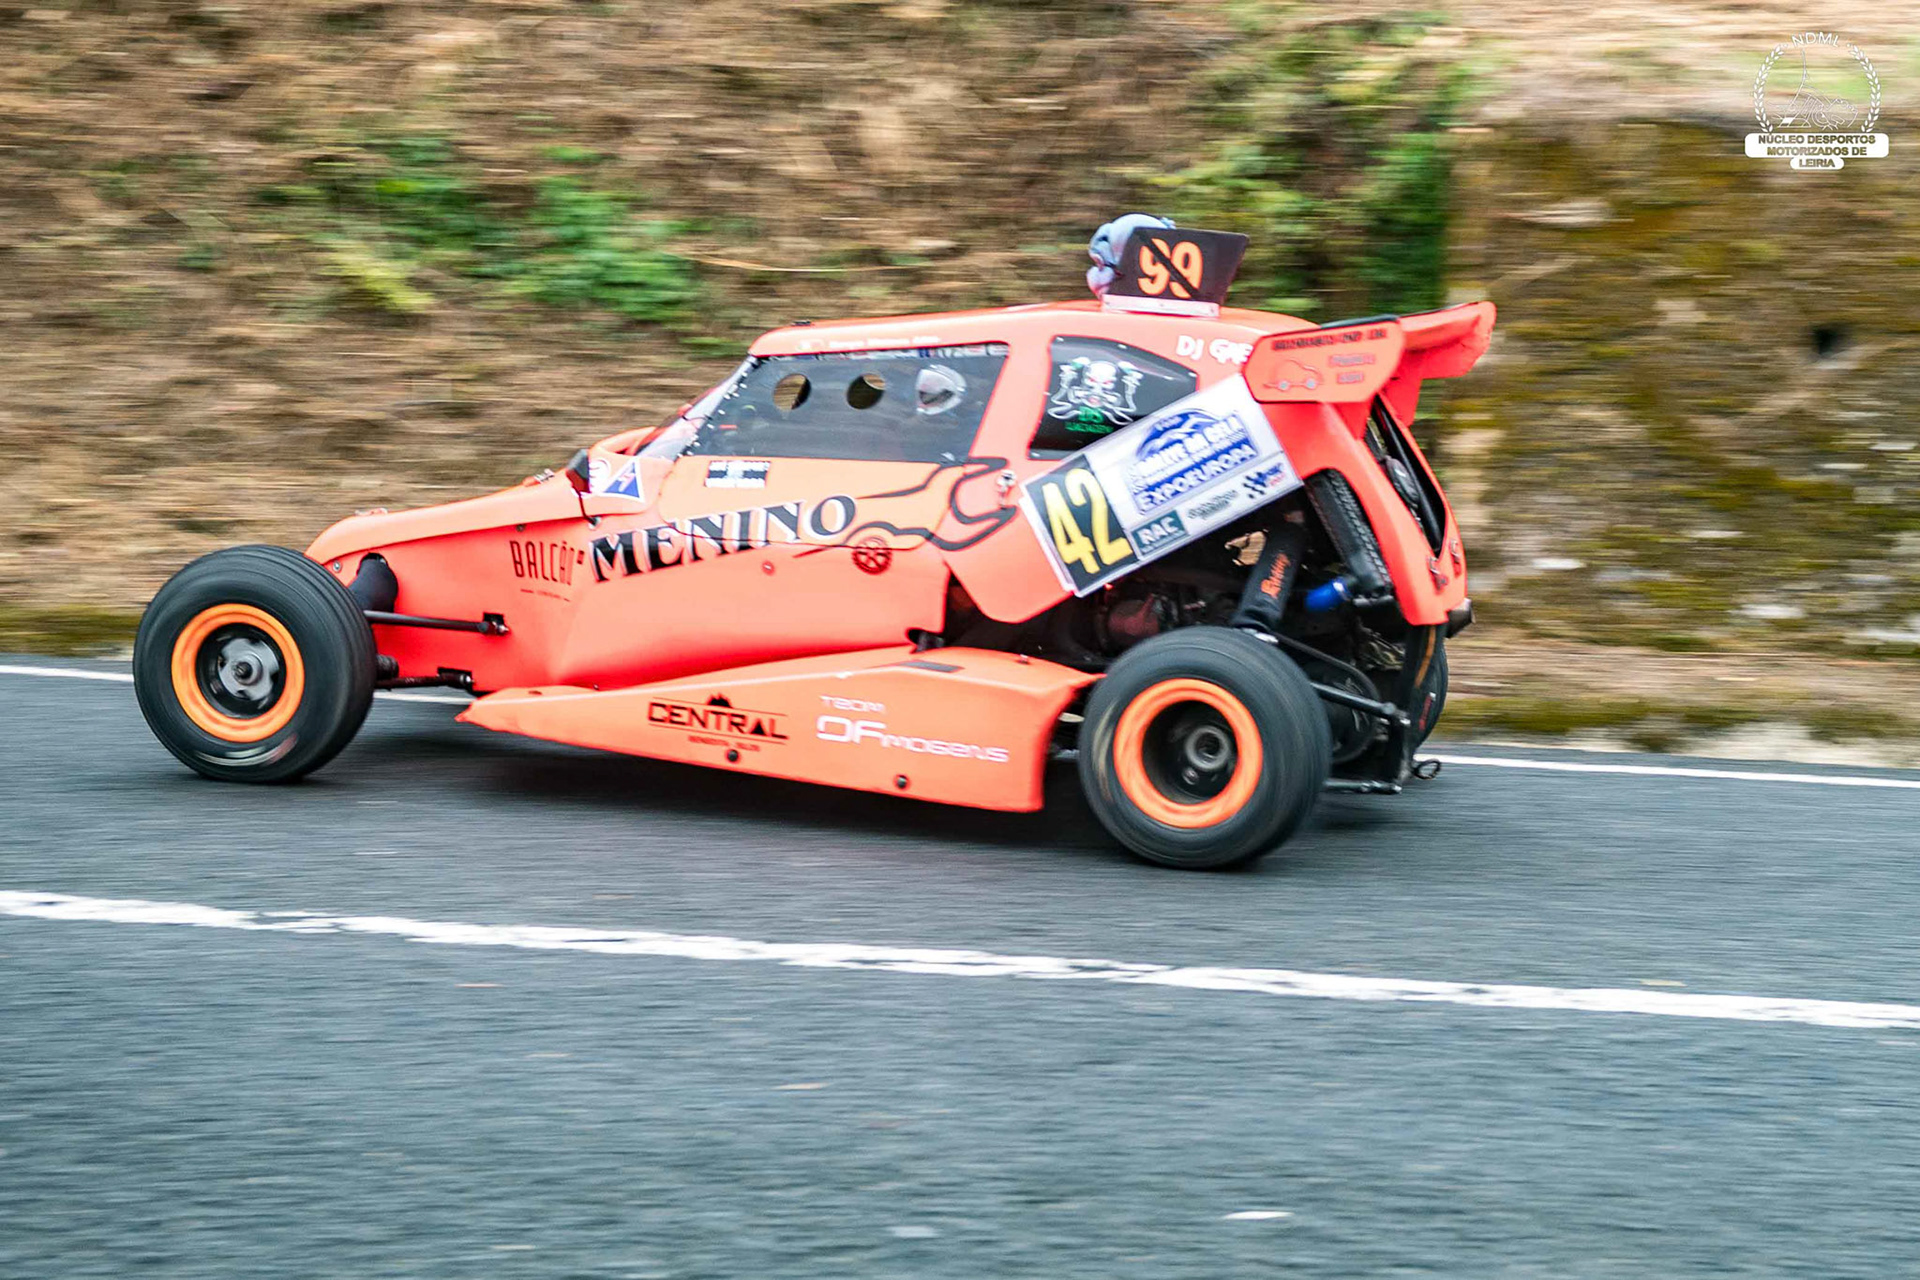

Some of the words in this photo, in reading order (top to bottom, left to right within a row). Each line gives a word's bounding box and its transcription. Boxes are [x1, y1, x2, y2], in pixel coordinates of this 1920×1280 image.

[588, 494, 856, 584] MENINO
[1042, 468, 1133, 574] 42
[1137, 516, 1178, 545] RAC
[648, 702, 789, 740] CENTRAL
